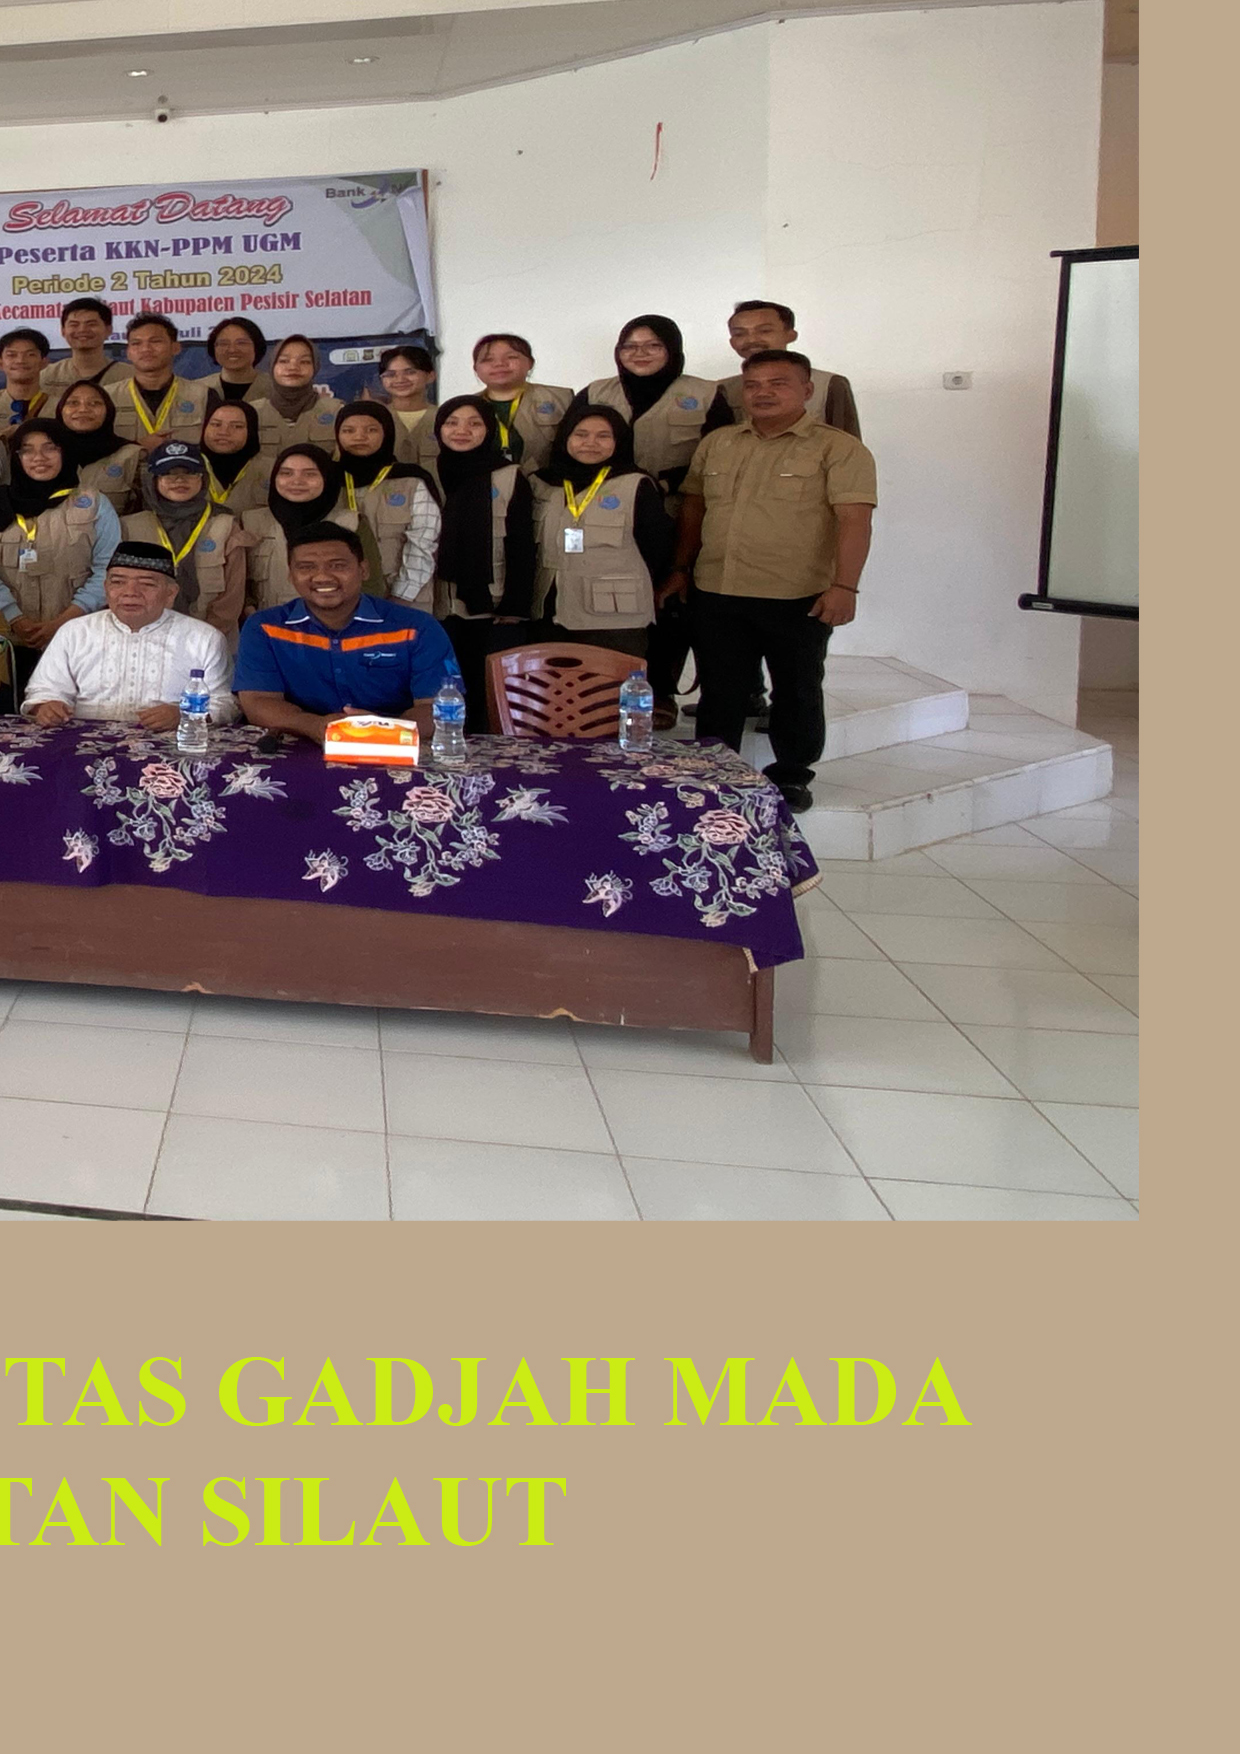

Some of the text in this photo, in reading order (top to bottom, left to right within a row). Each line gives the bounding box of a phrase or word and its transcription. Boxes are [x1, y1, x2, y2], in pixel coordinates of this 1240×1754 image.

[325, 186, 366, 199] Bank
[3, 191, 294, 233] Selamat Datang
[105, 235, 234, 260] KKN-PPM
[242, 231, 302, 253] UGM
[12, 264, 283, 295] Periode 2 Tahun 2024
[141, 295, 235, 316] Kabupaten
[240, 291, 303, 311] Pesisir
[305, 288, 372, 308] Selatan
